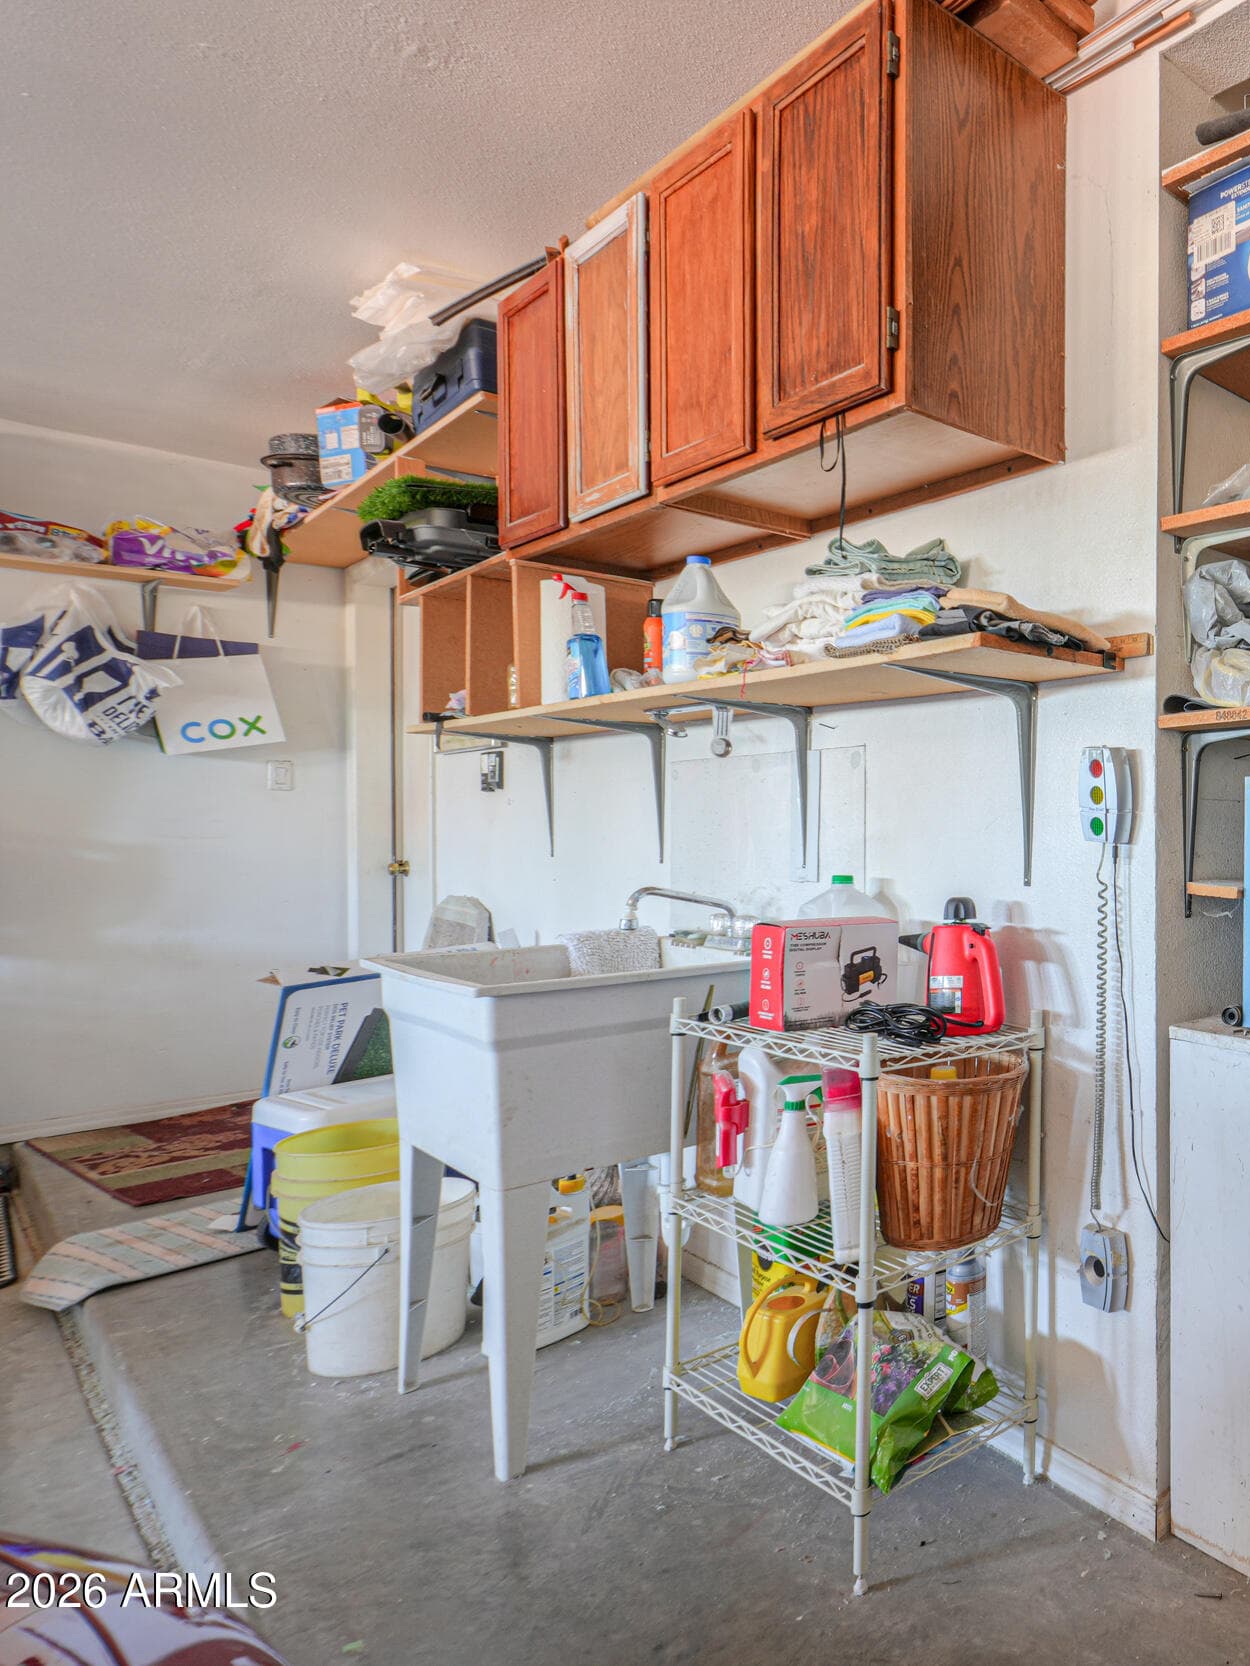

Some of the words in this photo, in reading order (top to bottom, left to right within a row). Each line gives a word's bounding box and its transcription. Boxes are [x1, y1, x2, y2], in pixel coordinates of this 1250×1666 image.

[180, 715, 267, 744] COX
[339, 1002, 349, 1017] PET
[335, 1020, 346, 1041] PARK
[327, 1044, 341, 1075] DELUXE
